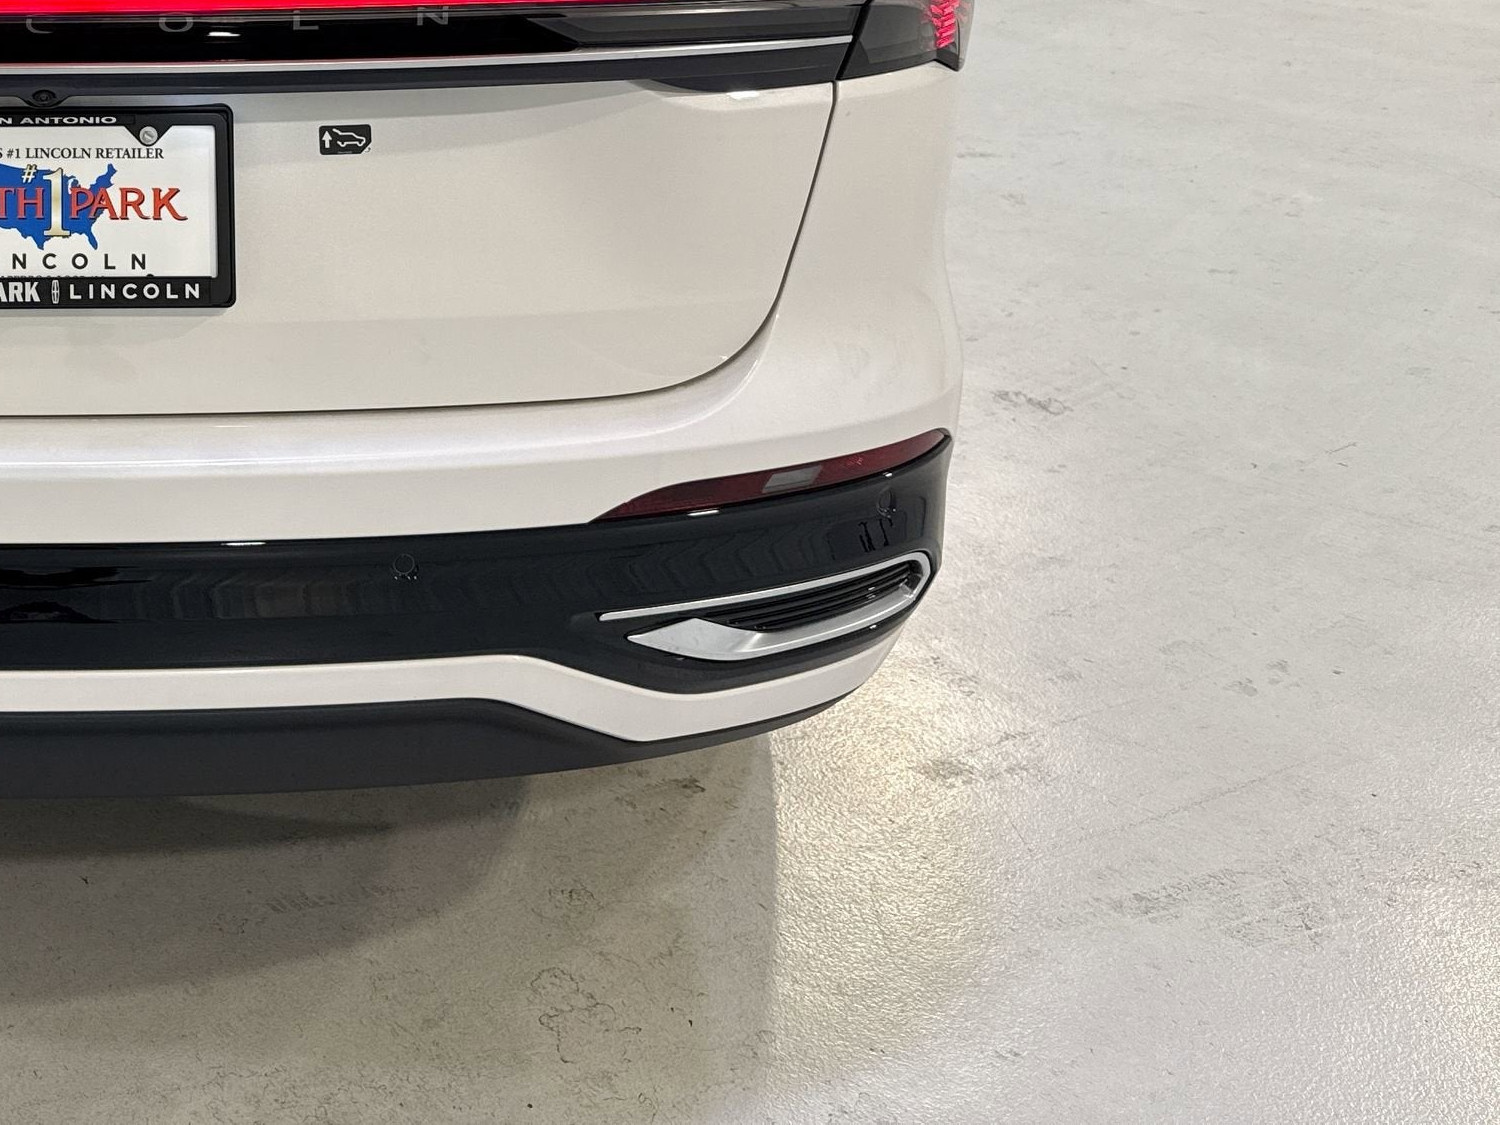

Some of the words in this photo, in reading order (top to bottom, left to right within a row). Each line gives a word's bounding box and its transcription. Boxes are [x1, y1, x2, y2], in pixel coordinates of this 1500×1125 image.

[20, 116, 117, 124] ANTONIO
[6, 148, 21, 159] #1
[25, 147, 91, 159] LINCOLN
[95, 147, 164, 159] RETAILER
[69, 187, 188, 221] PARK
[69, 283, 200, 300] LINCOLN
